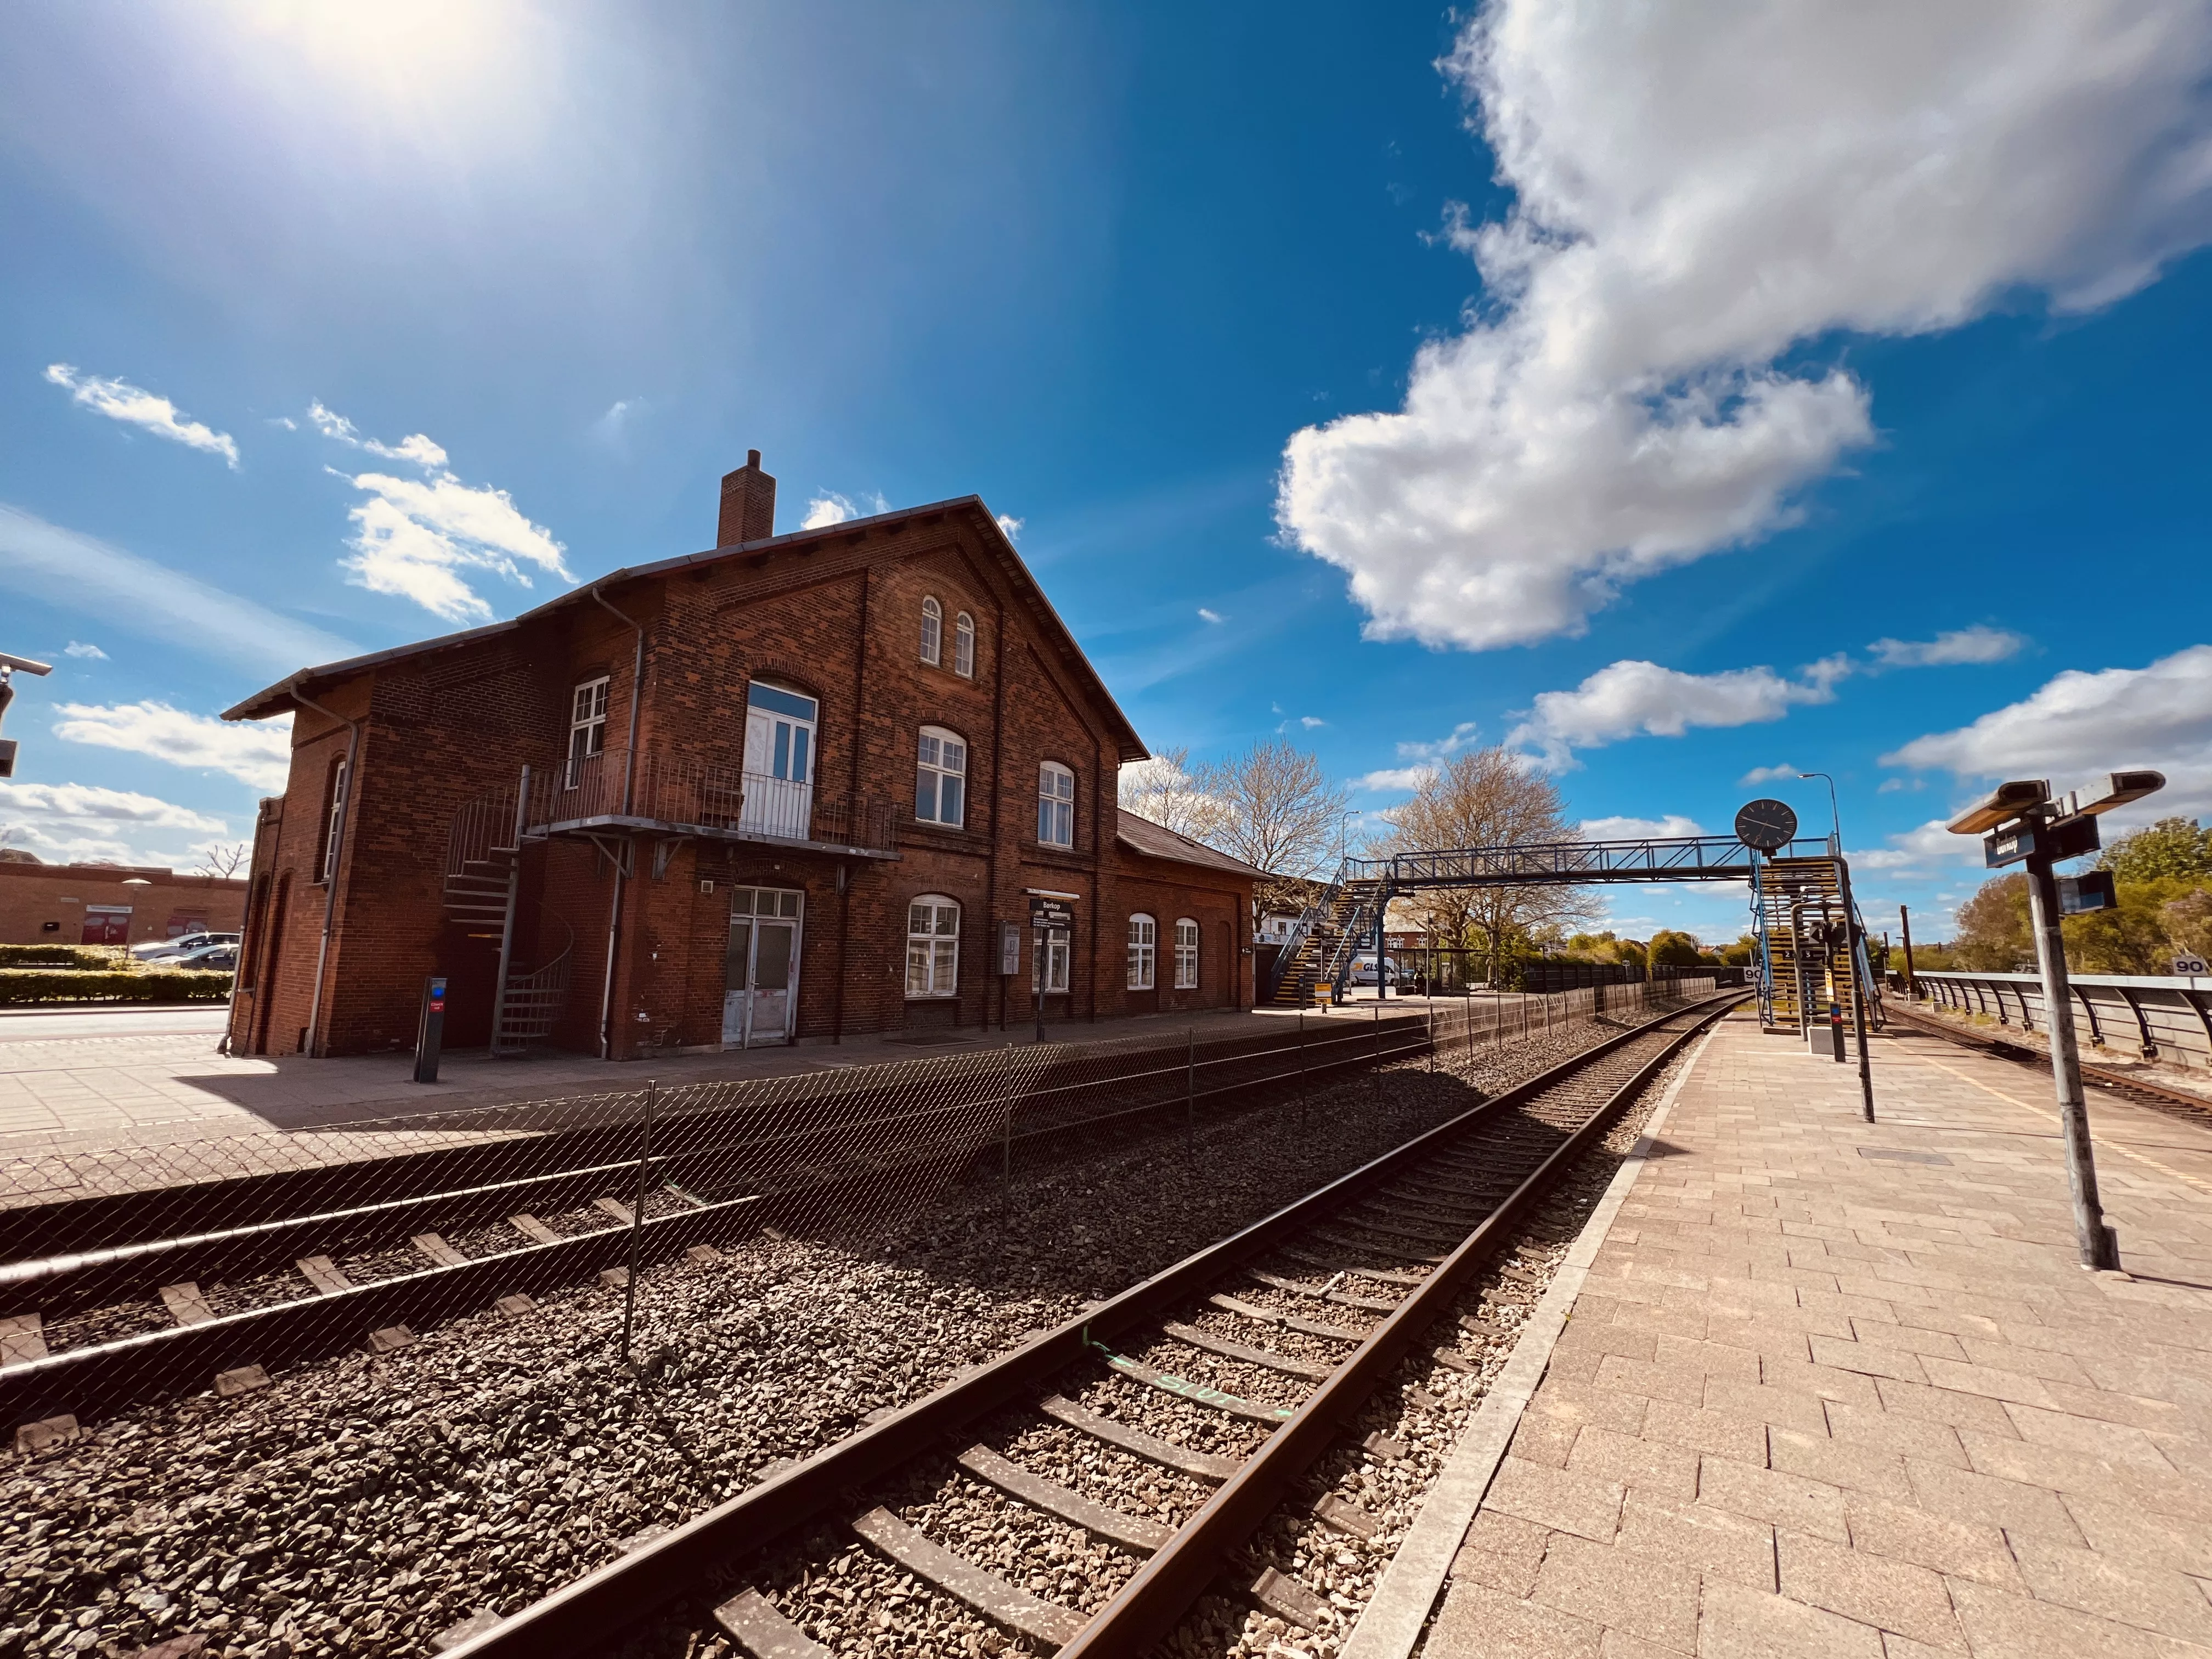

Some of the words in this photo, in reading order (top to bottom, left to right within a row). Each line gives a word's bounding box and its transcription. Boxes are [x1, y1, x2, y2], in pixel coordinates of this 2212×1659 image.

[1043, 901, 1060, 911] Børkop
[1363, 963, 1378, 972] GLS
[2176, 961, 2203, 972] 90
